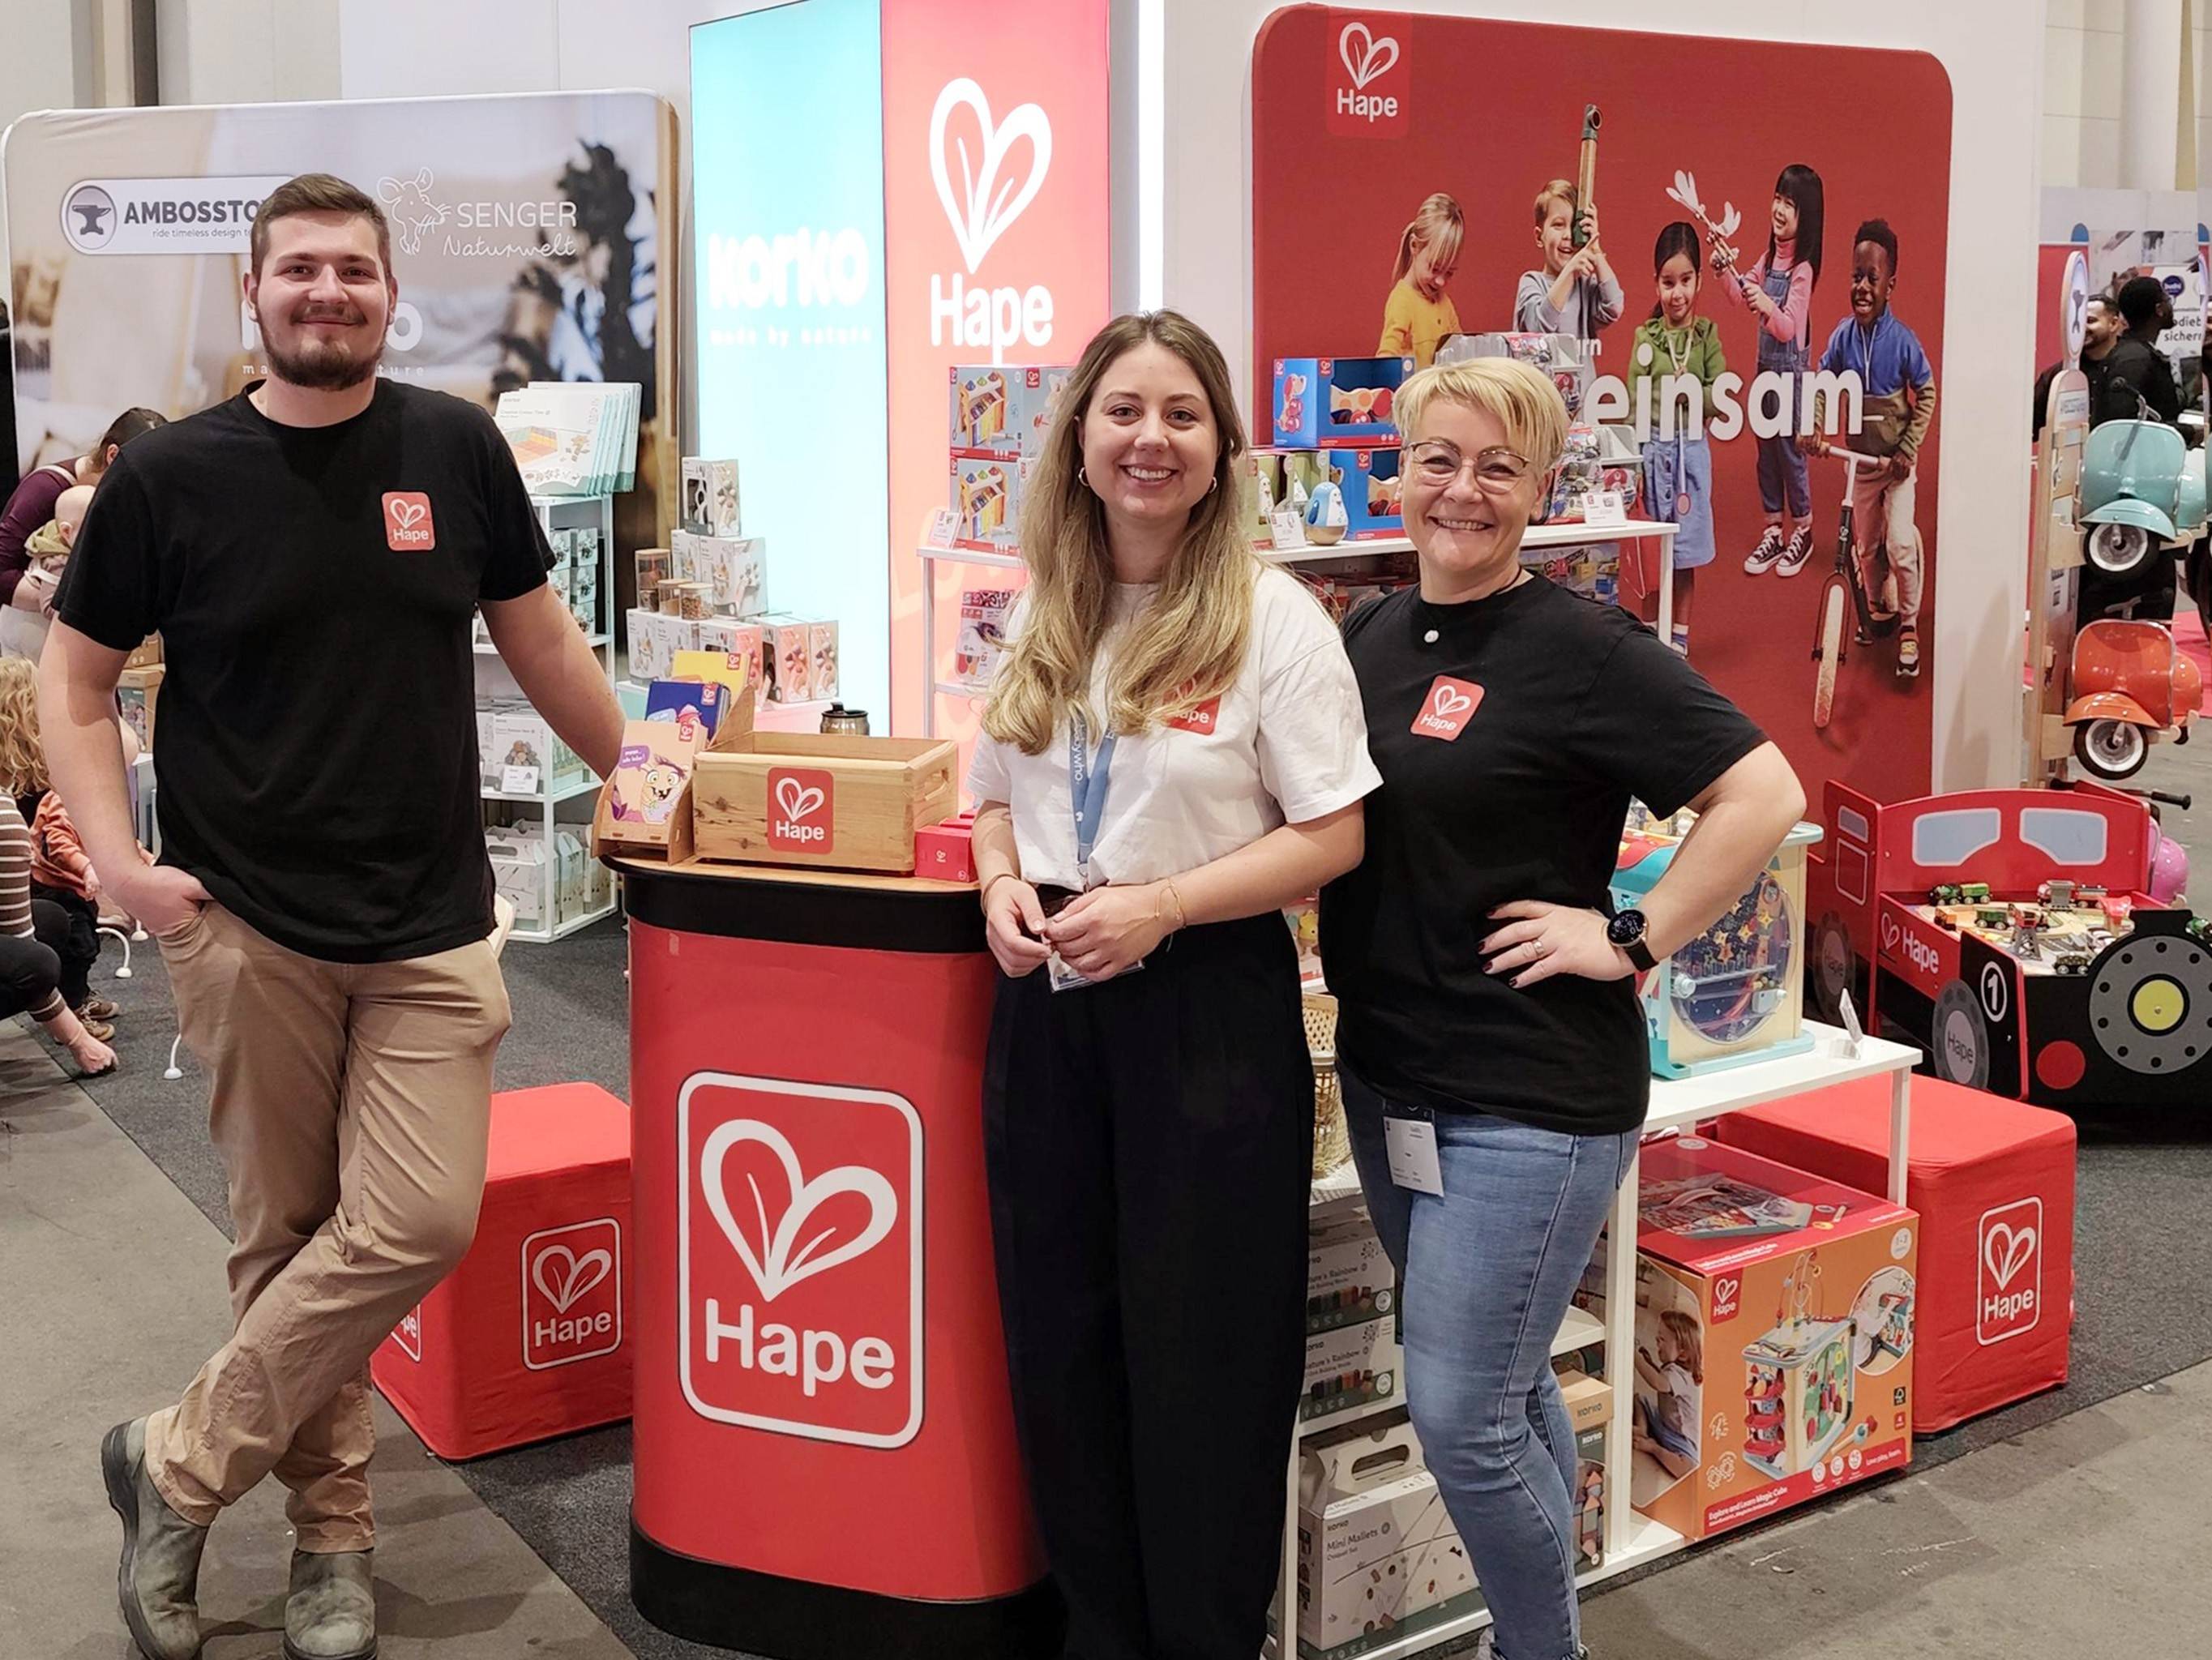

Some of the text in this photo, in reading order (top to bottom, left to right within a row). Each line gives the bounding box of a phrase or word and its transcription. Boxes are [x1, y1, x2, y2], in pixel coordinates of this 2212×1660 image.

[1337, 89, 1398, 122] Hape
[124, 199, 264, 225] AMBOSSTO
[456, 201, 577, 228] SENGER
[152, 229, 170, 237] ride
[172, 228, 209, 237] timeless
[211, 228, 242, 239] design
[443, 233, 576, 258] Naturwelt
[708, 225, 871, 310] korko
[931, 272, 1054, 366] Hape
[242, 365, 425, 375] ma ture
[1583, 343, 1863, 442] einsam
[392, 528, 429, 544] Hape
[1177, 710, 1209, 725] ape
[1419, 713, 1457, 731] Hape
[776, 819, 825, 844] Hape
[1902, 926, 1940, 974] Hape
[1987, 973, 1999, 1012] 1
[1947, 1031, 1975, 1065] Hape
[1713, 1301, 1736, 1317] Hape
[1984, 1288, 2035, 1324] Hape
[403, 1314, 418, 1338] pe
[535, 1311, 612, 1348] Hape
[704, 1298, 896, 1397] Hape
[1307, 1341, 1324, 1352] orko
[1577, 1402, 1602, 1418] korko
[1326, 1519, 1349, 1532] korko
[1326, 1528, 1379, 1551] Mini Mallets
